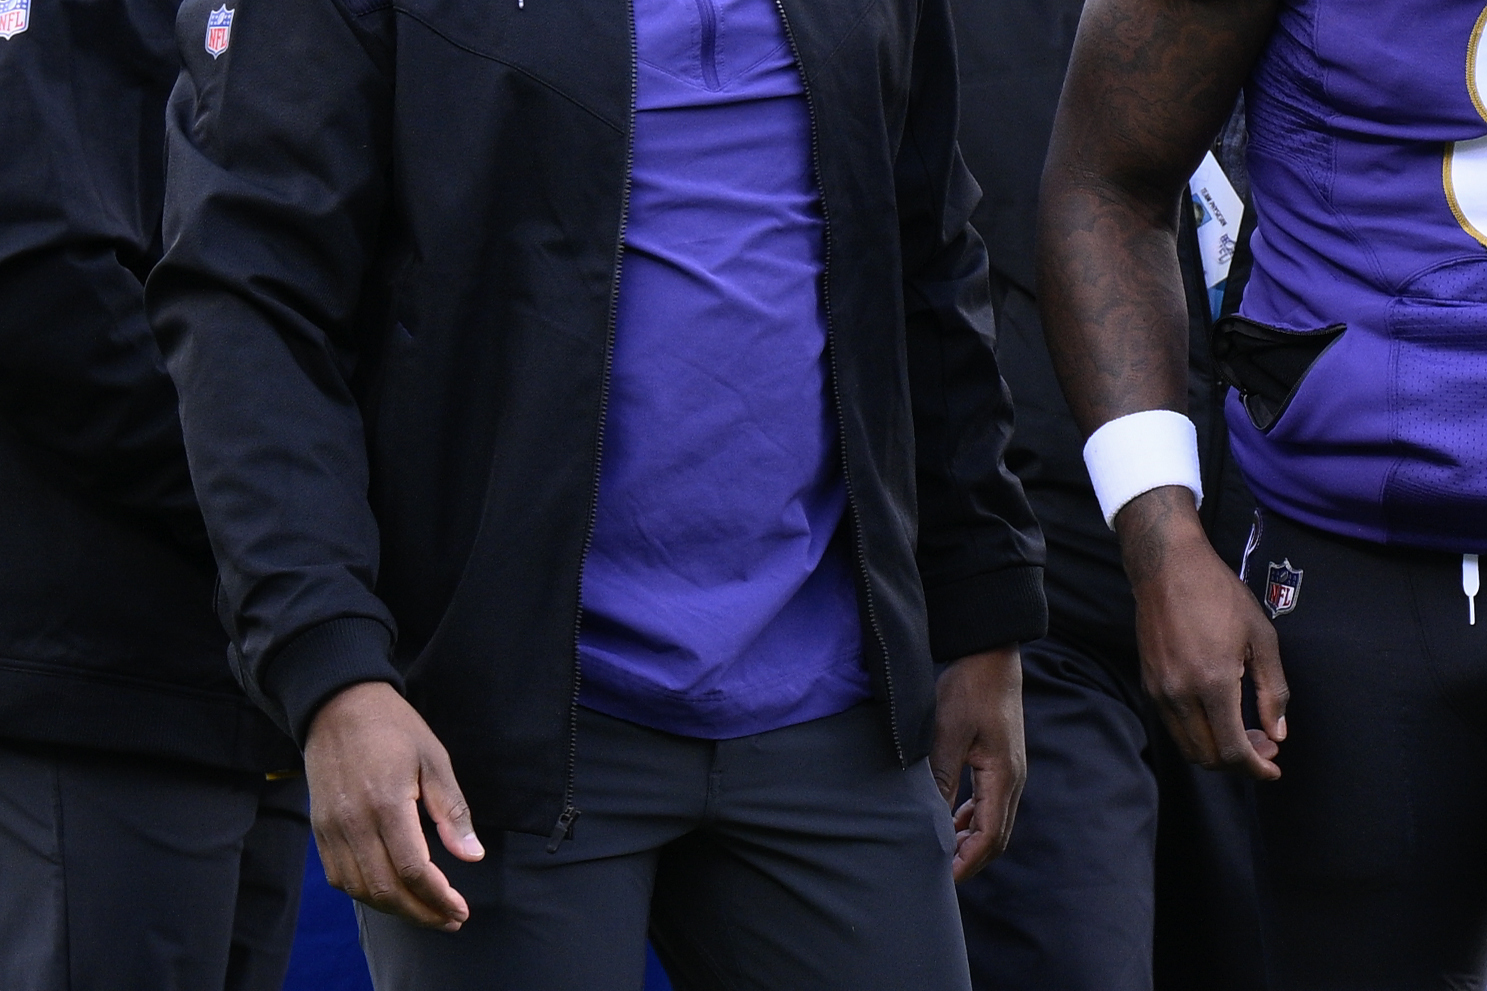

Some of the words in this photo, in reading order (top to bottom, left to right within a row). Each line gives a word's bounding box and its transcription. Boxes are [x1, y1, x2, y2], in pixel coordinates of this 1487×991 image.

[0, 11, 24, 31] NFL
[208, 28, 228, 50] NFL
[1269, 584, 1291, 607] NFL
